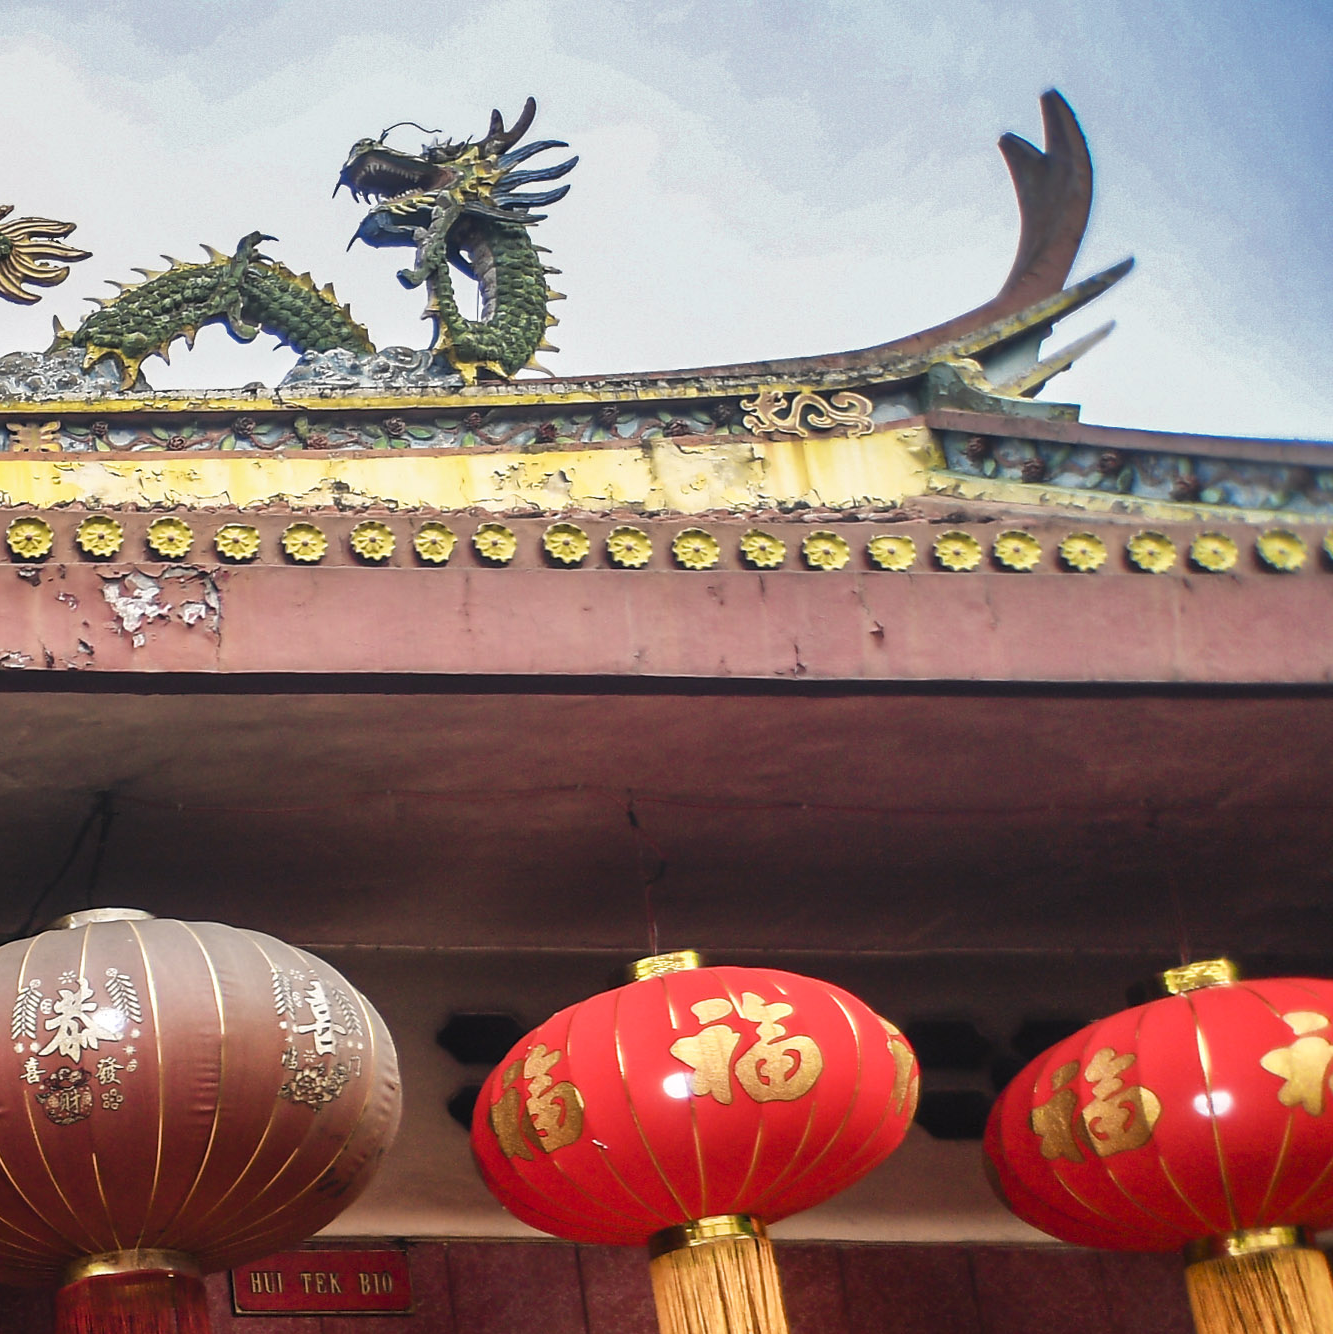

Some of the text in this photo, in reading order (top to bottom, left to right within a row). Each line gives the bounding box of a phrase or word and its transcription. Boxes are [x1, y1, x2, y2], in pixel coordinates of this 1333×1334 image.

[36, 977, 125, 1064] 恭
[297, 980, 347, 1056] 喜
[670, 992, 824, 1104] 福
[20, 1055, 124, 1085] 喜 發
[489, 1043, 585, 1161] 福
[1028, 1048, 1162, 1163] 福
[250, 1271, 393, 1295] HUI TEK BIO
